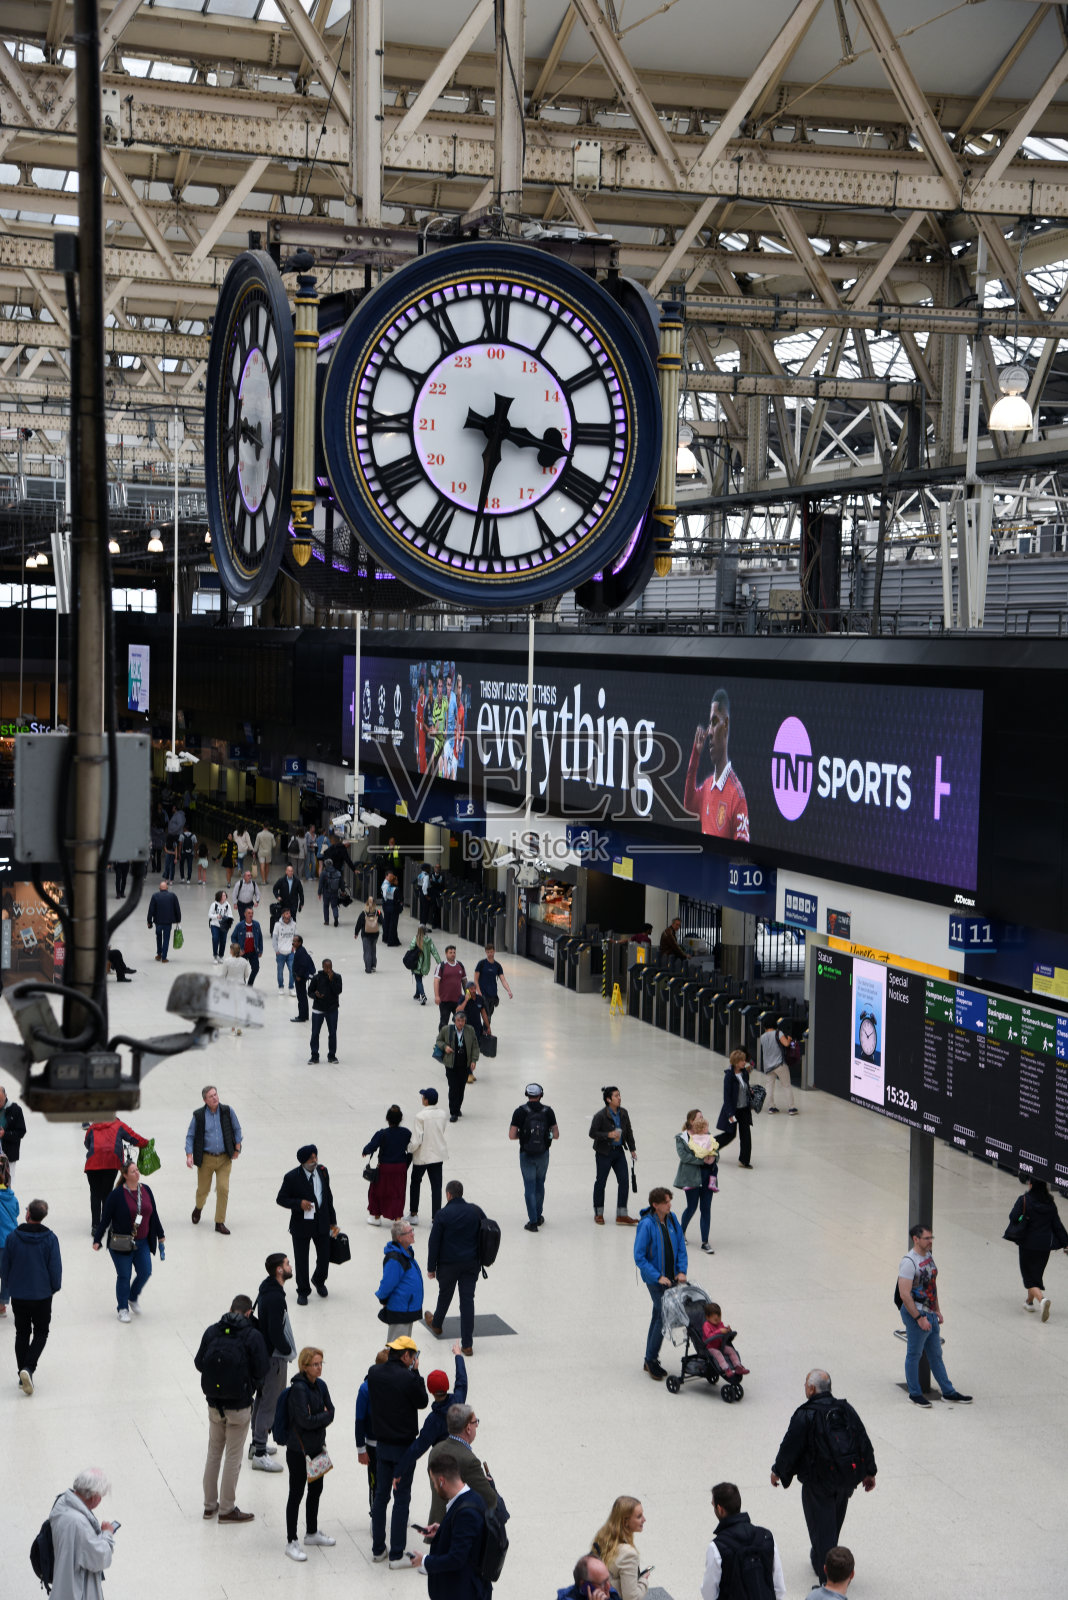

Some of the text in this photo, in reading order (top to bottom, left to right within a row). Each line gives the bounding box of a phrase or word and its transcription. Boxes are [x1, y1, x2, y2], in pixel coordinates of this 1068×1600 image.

[487, 347, 505, 360] 00
[454, 356, 472, 369] 23
[521, 361, 538, 373] 13
[429, 382, 447, 395] 22
[544, 390, 560, 402] 14
[419, 418, 435, 430] 21
[427, 454, 445, 465] 20
[451, 482, 467, 493] 19
[519, 488, 535, 500] 17
[485, 497, 500, 509] 18
[480, 680, 492, 699] THIS
[504, 682, 518, 702] JUST
[538, 685, 551, 705] THIS
[551, 685, 557, 706] IS
[476, 683, 656, 817] everything
[291, 761, 299, 771] 6
[771, 751, 912, 811] TNT SPORTS
[467, 803, 475, 815] 8
[580, 830, 590, 844] 9
[729, 869, 763, 886] 10 10
[13, 906, 48, 916] WOW
[951, 922, 993, 943] 11 11
[817, 951, 833, 964] Status
[888, 973, 909, 988] Special
[888, 988, 910, 1004] Notices
[942, 994, 954, 1005] Court
[987, 1025, 994, 1034] 14
[1021, 1035, 1028, 1045] 12
[1056, 1046, 1065, 1057] 1-6
[886, 1085, 918, 1111] 15:32 30
[988, 1149, 999, 1160] SWR
[1022, 1162, 1034, 1174] SWR
